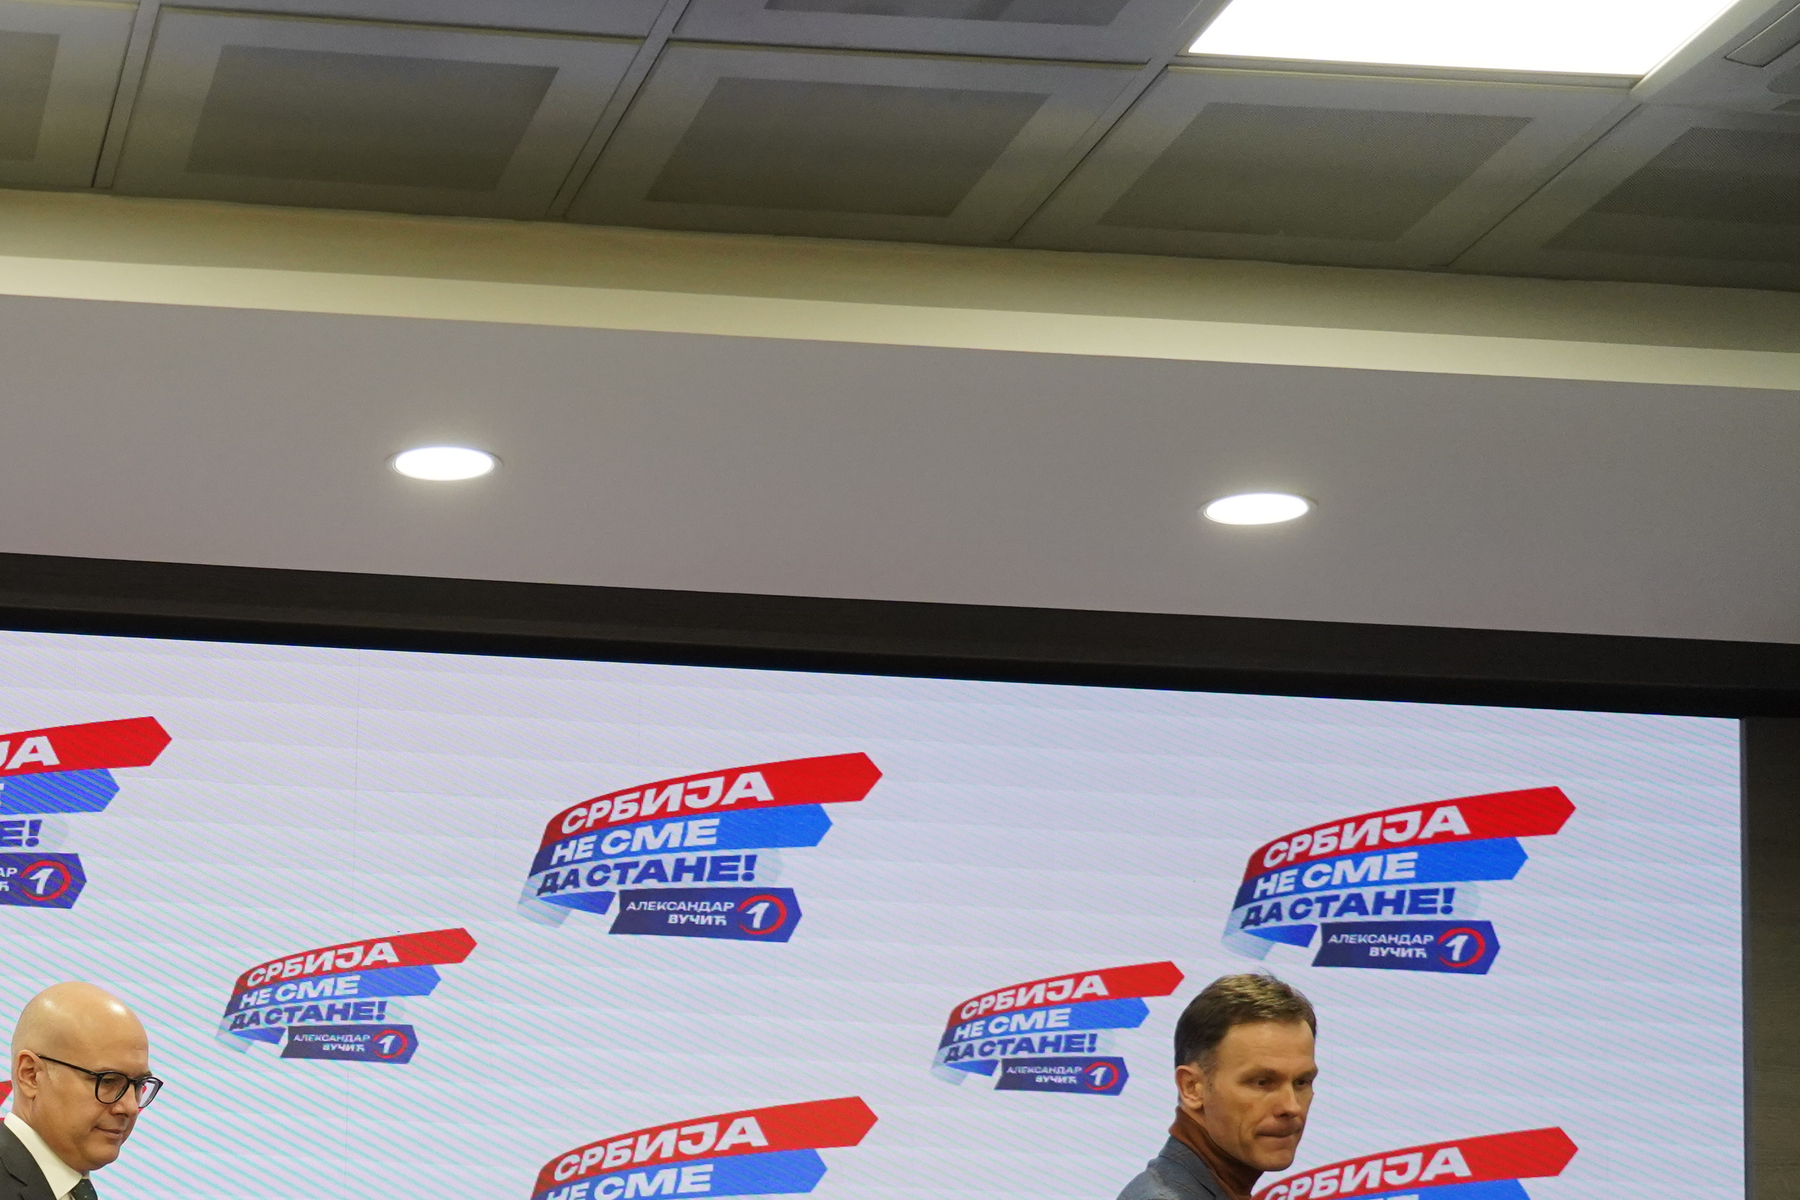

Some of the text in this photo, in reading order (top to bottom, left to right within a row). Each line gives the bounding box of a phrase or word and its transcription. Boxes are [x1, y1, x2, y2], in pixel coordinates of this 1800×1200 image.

[561, 771, 775, 834] СРБИЈА
[550, 818, 719, 865] НЕ СМЕ
[1263, 805, 1471, 868] СРБИЈА
[29, 868, 54, 895] 1
[535, 855, 758, 896] ДА СТАНЕ!
[1253, 852, 1418, 899] НЕ СМЕ
[626, 902, 734, 913] АЛЕКСАНДАР
[668, 913, 727, 926] ВУЧИЋ
[745, 903, 770, 929] 1
[1241, 888, 1456, 929] ДА СТАНЕ!
[1328, 934, 1434, 945] АЛЕКСАНДАР
[1369, 946, 1427, 958] ВУЧИЋ
[1445, 936, 1468, 961] 1
[246, 942, 399, 987] СРБИЈА
[239, 975, 361, 1009] НЕ СМЕ
[960, 975, 1108, 1019] СРБИЈА
[229, 1001, 387, 1031] ДА СТАНЕ!
[953, 1007, 1072, 1042] НЕ СМЕ
[379, 1035, 395, 1053] 1
[943, 1033, 1098, 1063] ДА СТАНЕ!
[1089, 1067, 1106, 1086] 1
[553, 1116, 768, 1181] СРБИЈА
